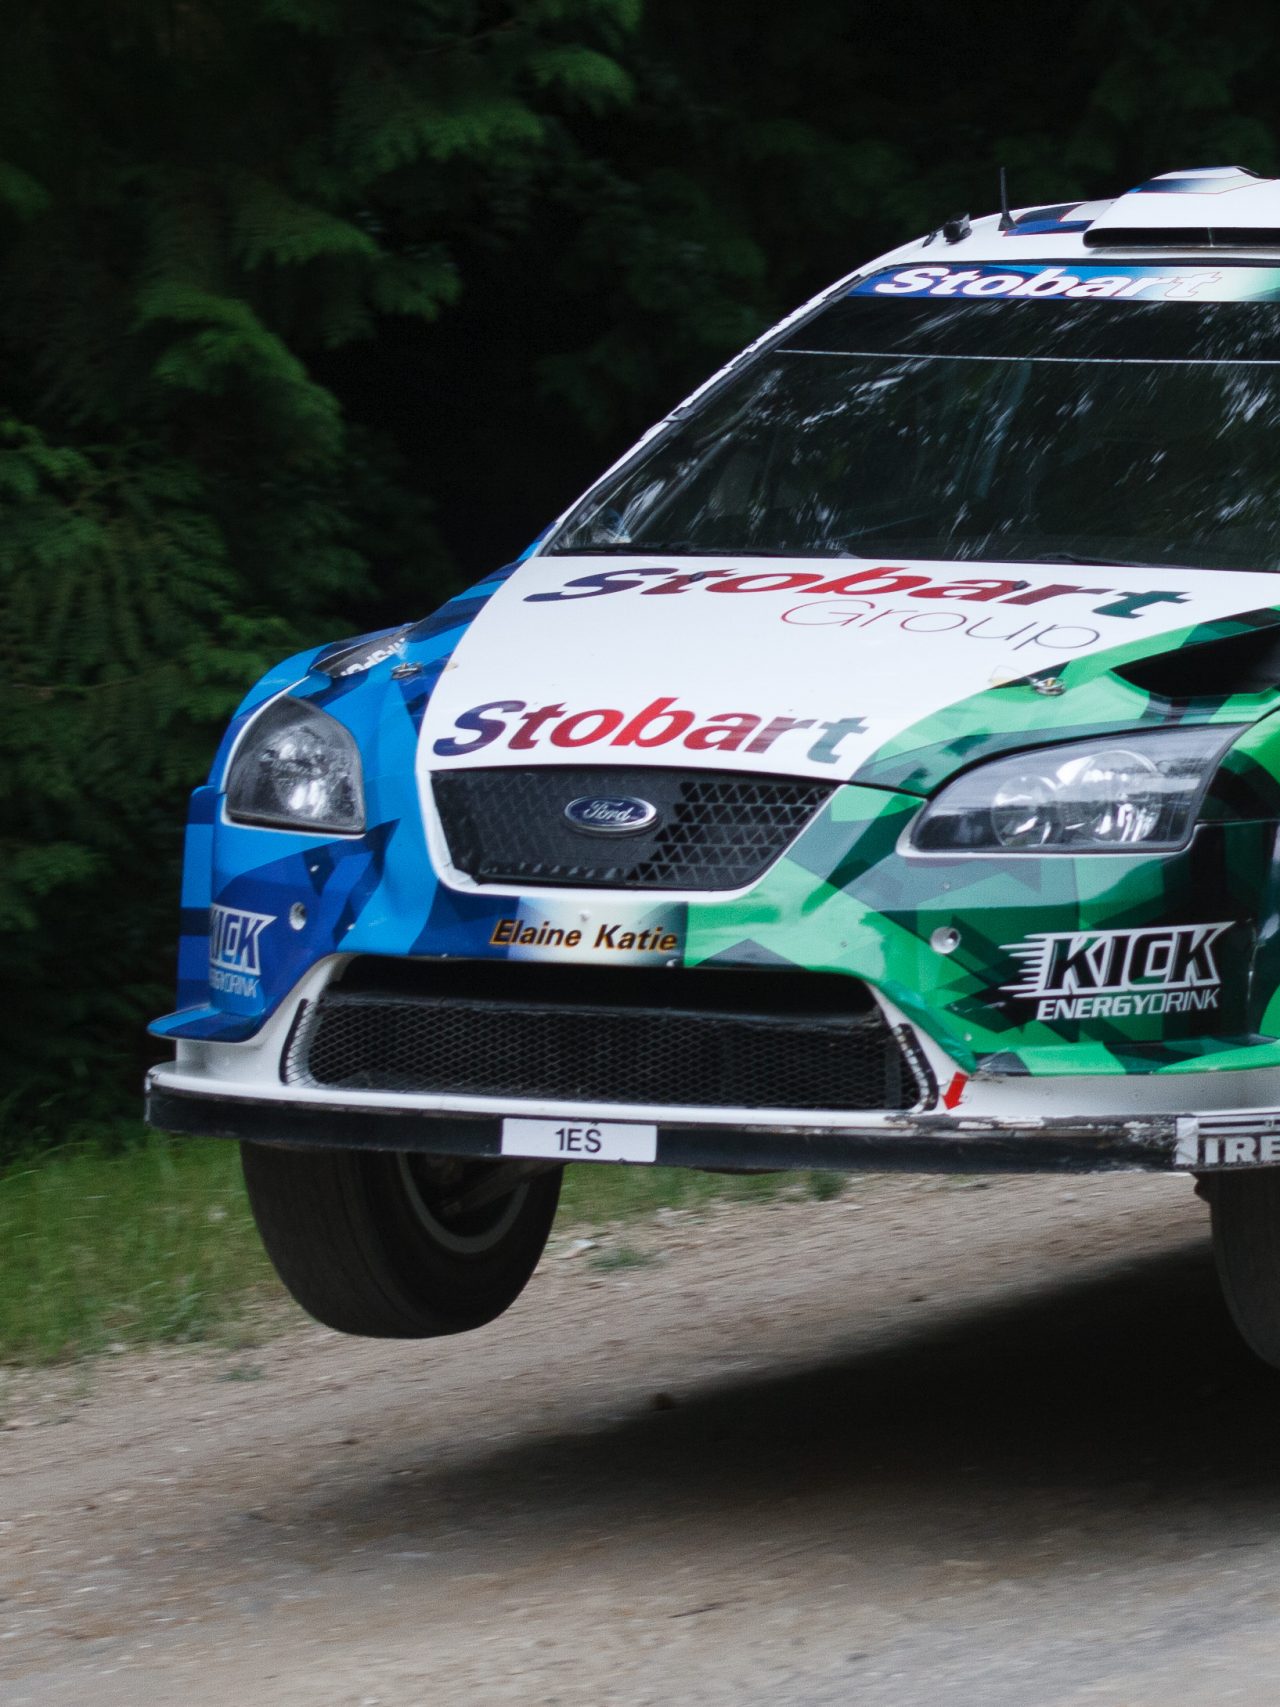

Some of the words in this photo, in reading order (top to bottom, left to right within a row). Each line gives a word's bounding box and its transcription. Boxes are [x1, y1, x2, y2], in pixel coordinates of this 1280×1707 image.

[875, 267, 1223, 298] Stobart
[523, 567, 1193, 619] Stobart
[781, 599, 1100, 650] Group
[432, 697, 869, 764] Stobart
[583, 800, 634, 822] Ford
[489, 919, 582, 947] Elaine
[594, 924, 678, 951] Katie
[1008, 920, 1240, 998] KICK
[1036, 988, 1220, 1021] ENERGYDRINK
[555, 1128, 602, 1153] 1ES
